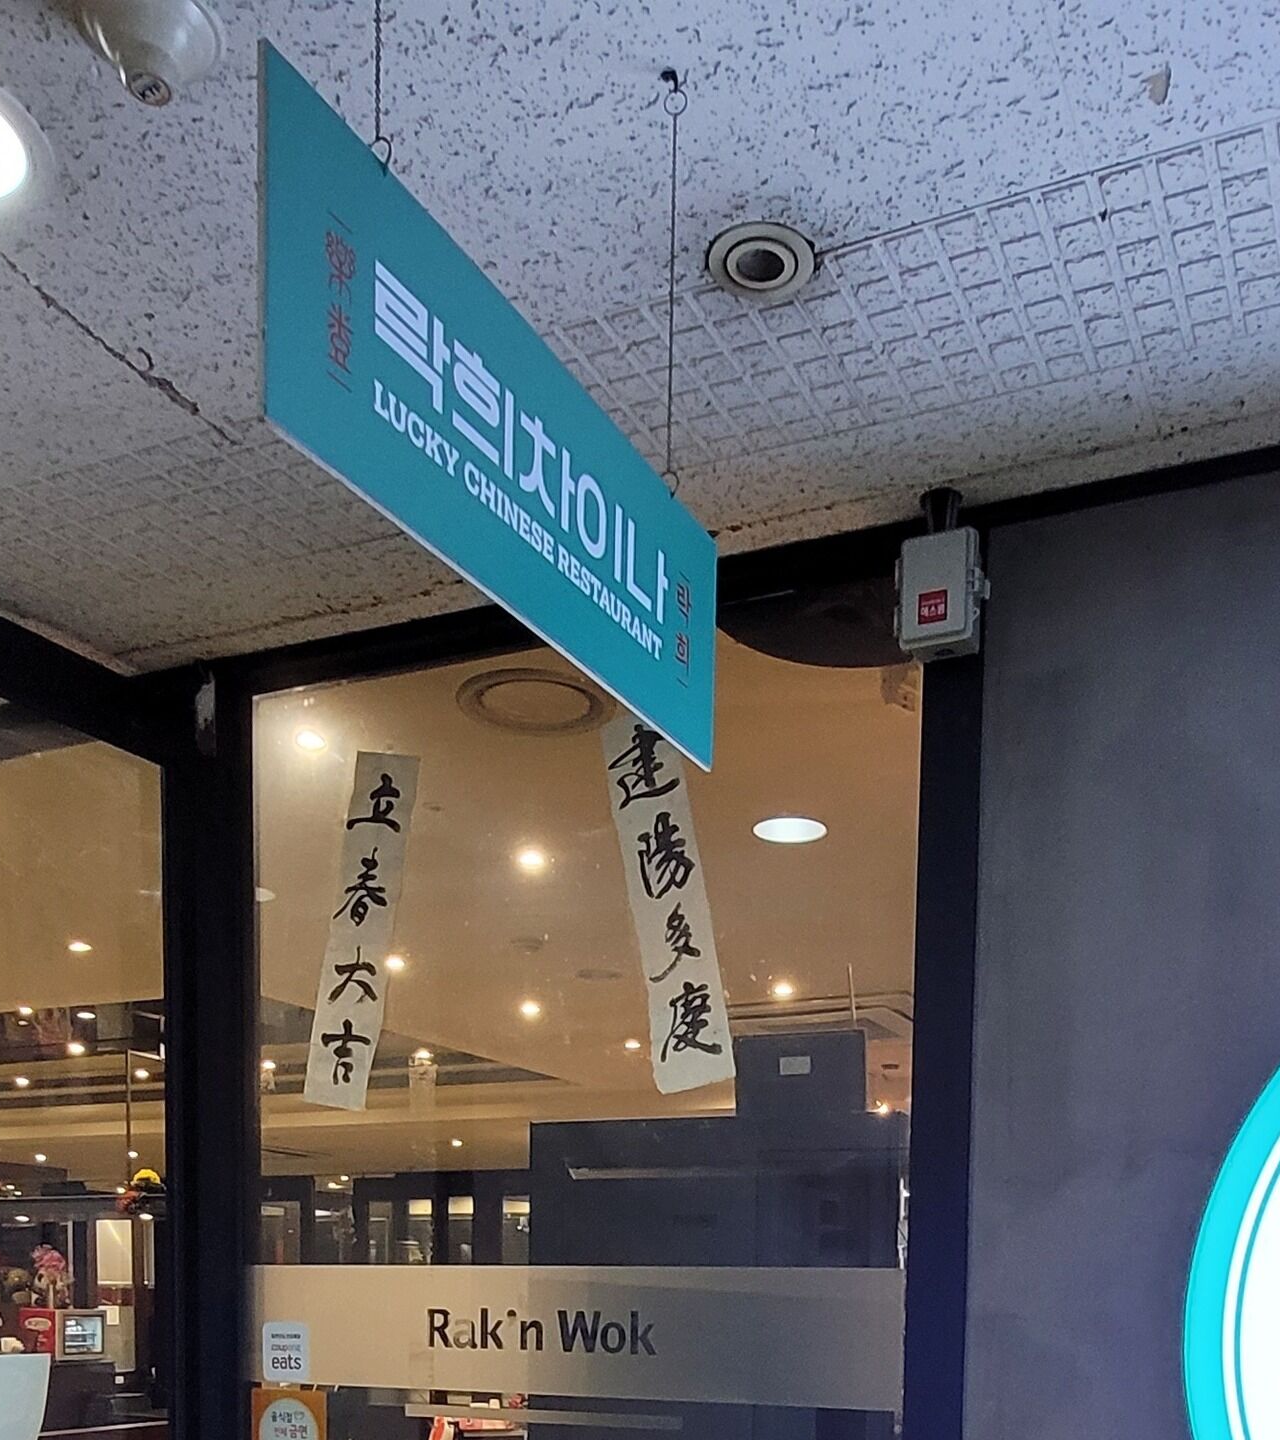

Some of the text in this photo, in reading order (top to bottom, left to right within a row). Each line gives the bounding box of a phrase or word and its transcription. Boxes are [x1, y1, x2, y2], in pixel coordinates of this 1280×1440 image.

[373, 380, 664, 661] LUCKY CHINESE RESTAURANT
[321, 773, 401, 1086] 立春大吉
[427, 1308, 657, 1356] Rak'n Wok
[271, 1353, 302, 1370] eats
[288, 1424, 308, 1439] 금연
